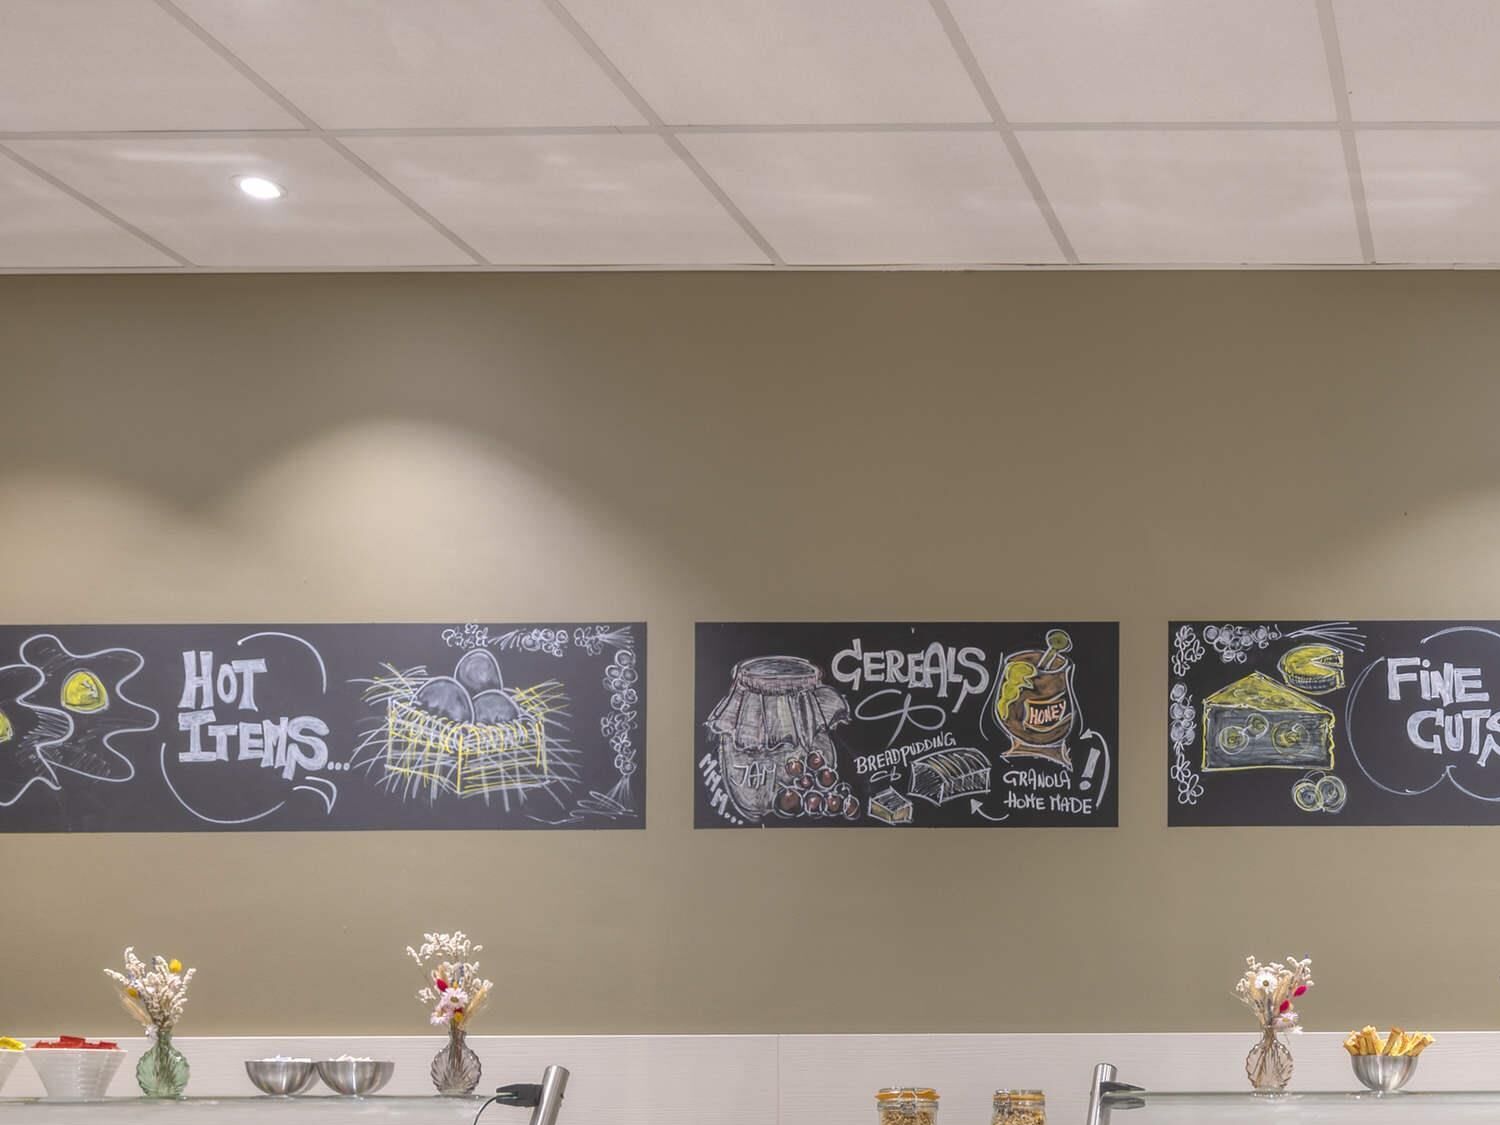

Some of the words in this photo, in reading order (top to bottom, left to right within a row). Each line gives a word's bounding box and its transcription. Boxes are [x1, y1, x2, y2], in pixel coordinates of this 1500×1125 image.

[177, 650, 268, 712] HOT
[831, 638, 989, 713] CEREALS
[1029, 701, 1066, 725] HONEY
[732, 761, 777, 790] JAM
[1002, 768, 1071, 790] GRANOLA
[1003, 790, 1046, 811] HOME
[1050, 795, 1093, 815] MADE
